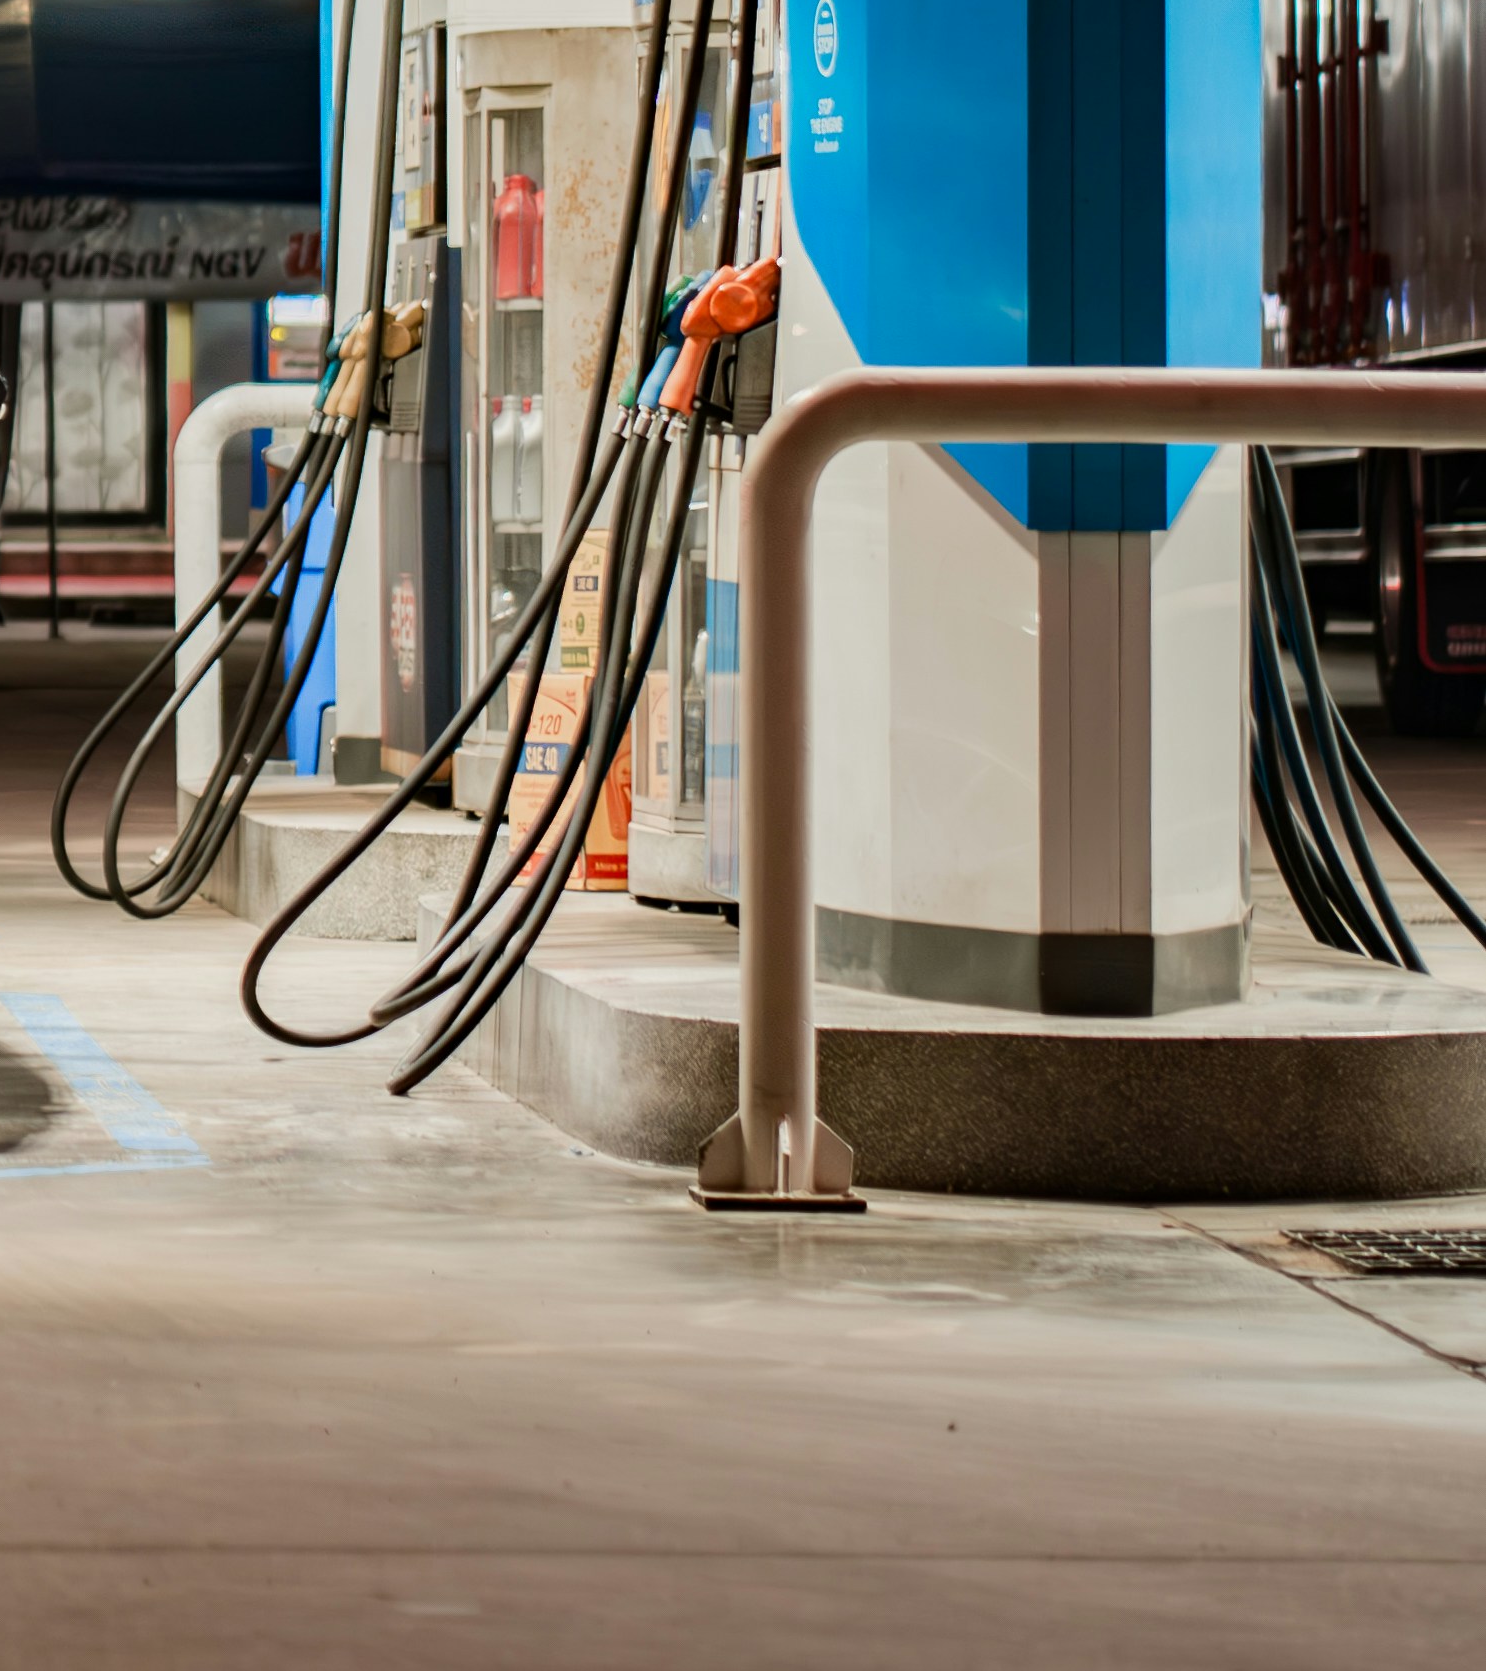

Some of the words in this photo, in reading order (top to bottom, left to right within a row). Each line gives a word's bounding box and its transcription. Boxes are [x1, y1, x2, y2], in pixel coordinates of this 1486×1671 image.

[189, 247, 267, 281] NGV
[524, 745, 545, 772] SAE
[545, 745, 559, 772] 40
